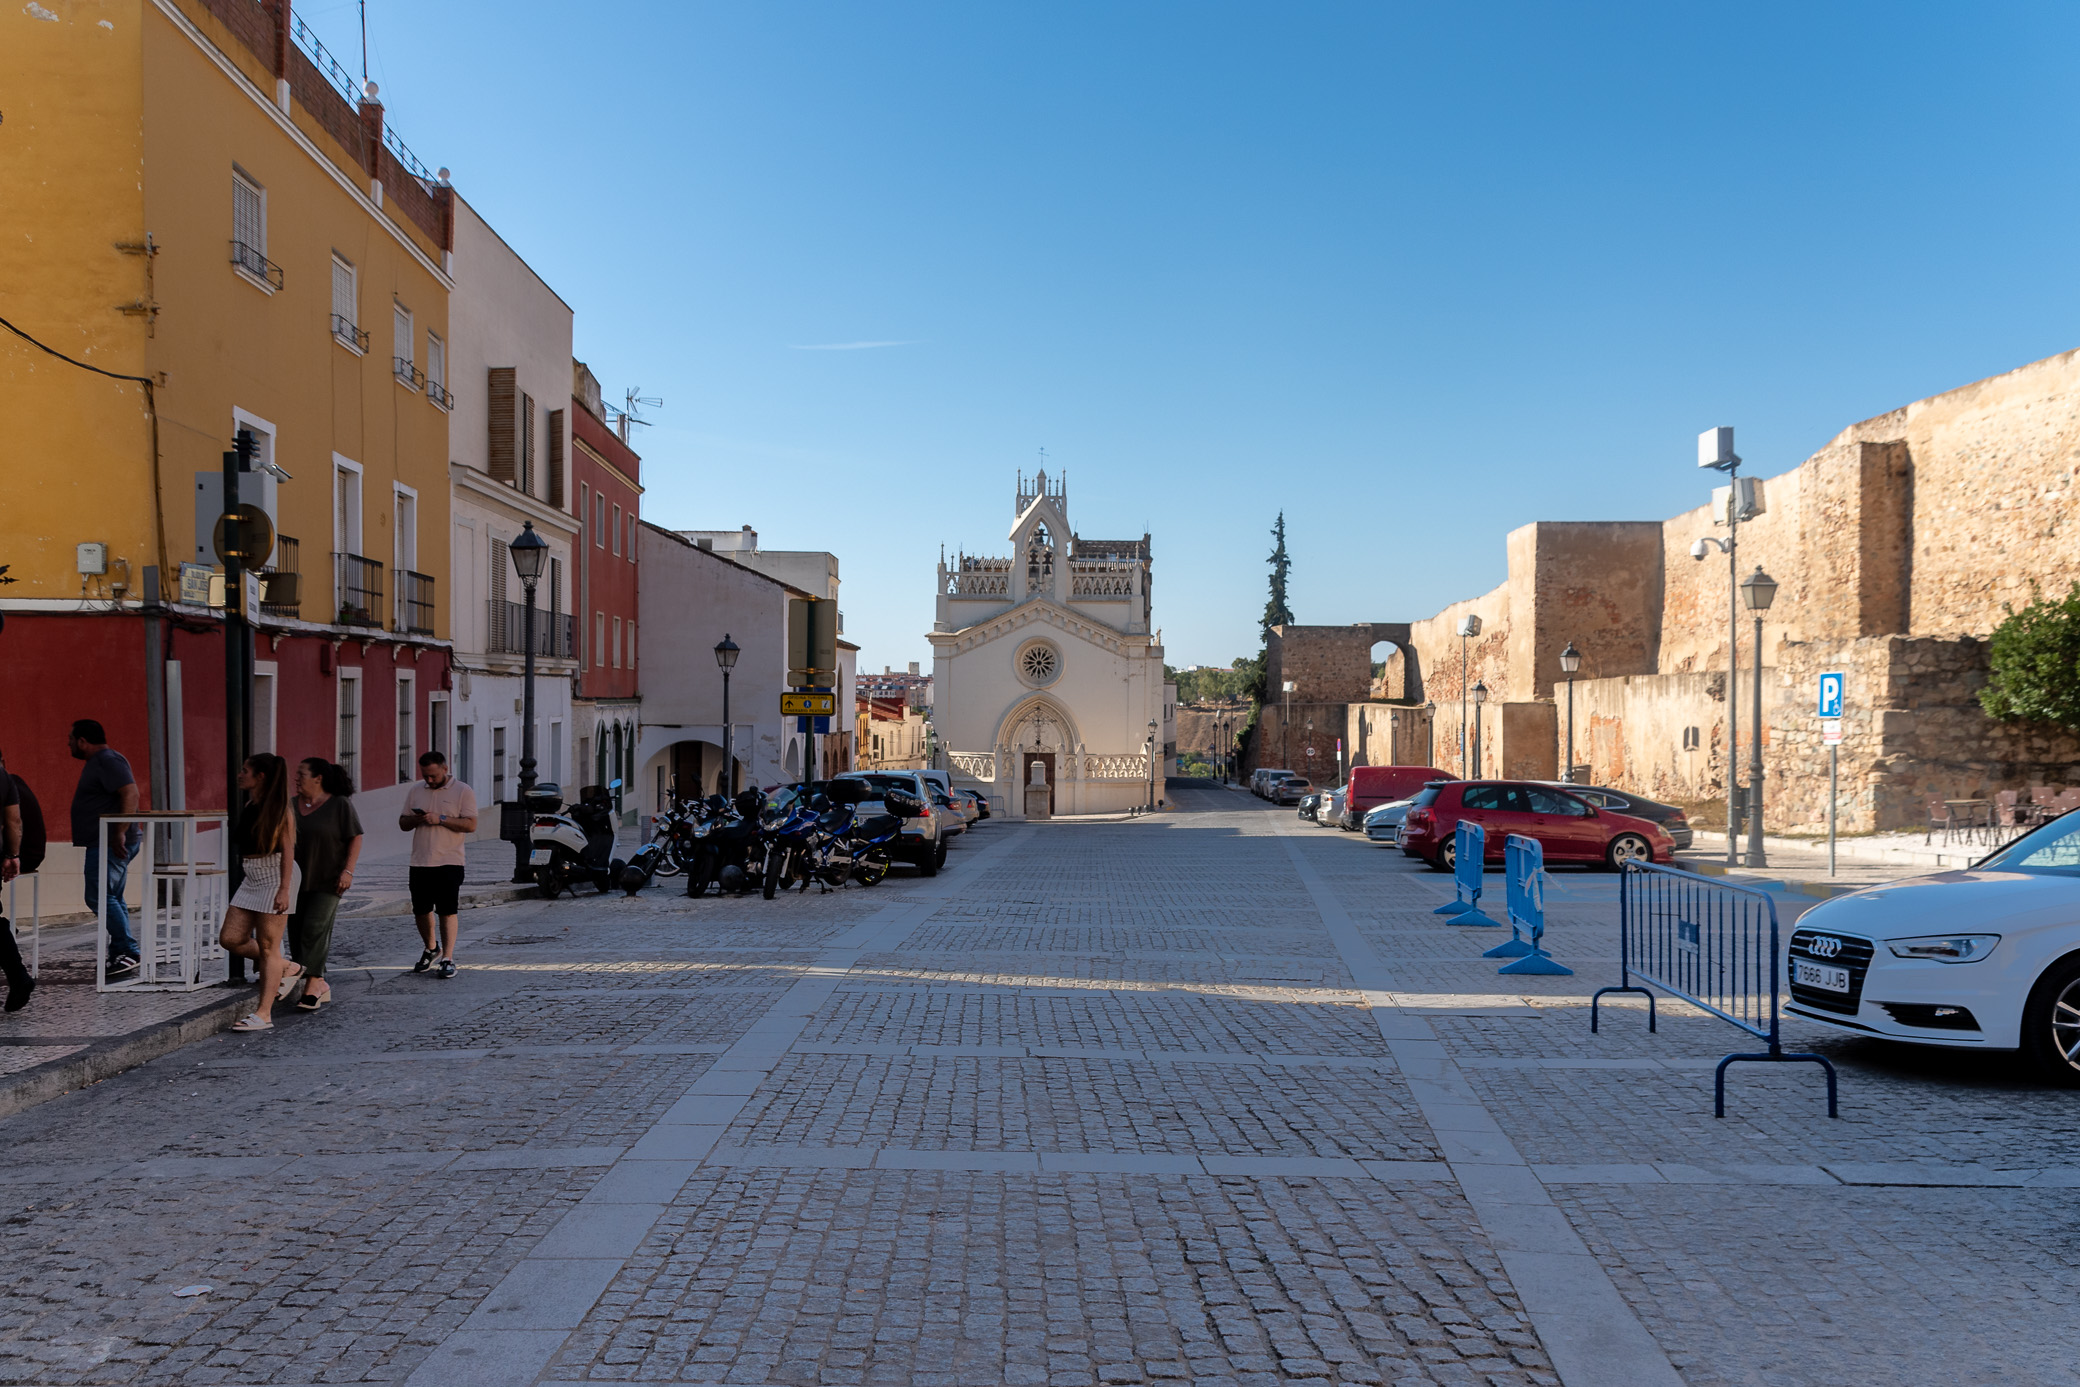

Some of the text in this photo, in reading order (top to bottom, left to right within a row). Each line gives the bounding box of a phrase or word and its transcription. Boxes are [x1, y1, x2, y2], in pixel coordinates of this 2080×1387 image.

[1822, 677, 1839, 713] P
[1798, 964, 1846, 988] 7666 JJB
